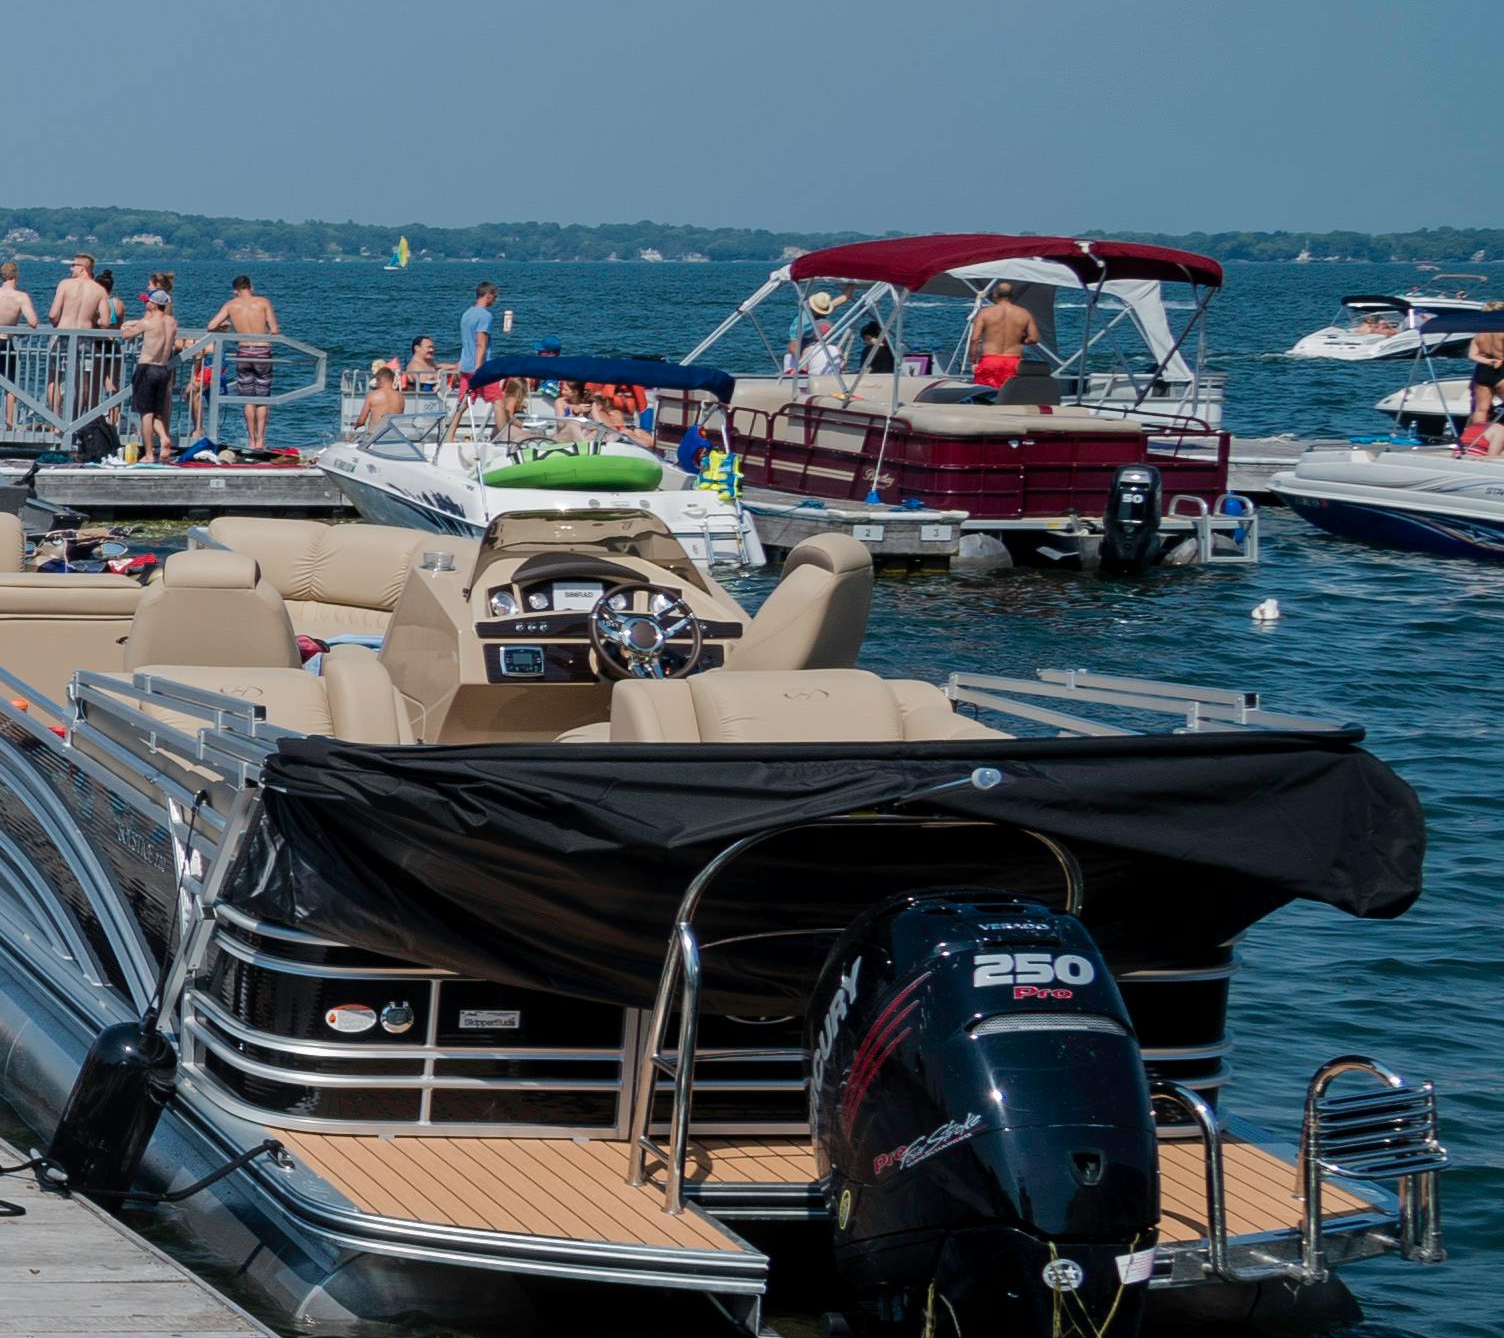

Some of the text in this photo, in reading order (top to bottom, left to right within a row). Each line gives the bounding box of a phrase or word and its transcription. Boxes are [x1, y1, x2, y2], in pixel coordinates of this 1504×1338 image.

[1122, 493, 1144, 504] 50
[864, 528, 871, 537] 2
[932, 528, 939, 537] 3
[973, 953, 1095, 988] 250
[1013, 985, 1073, 999] Pro
[873, 1145, 908, 1174] Pro
